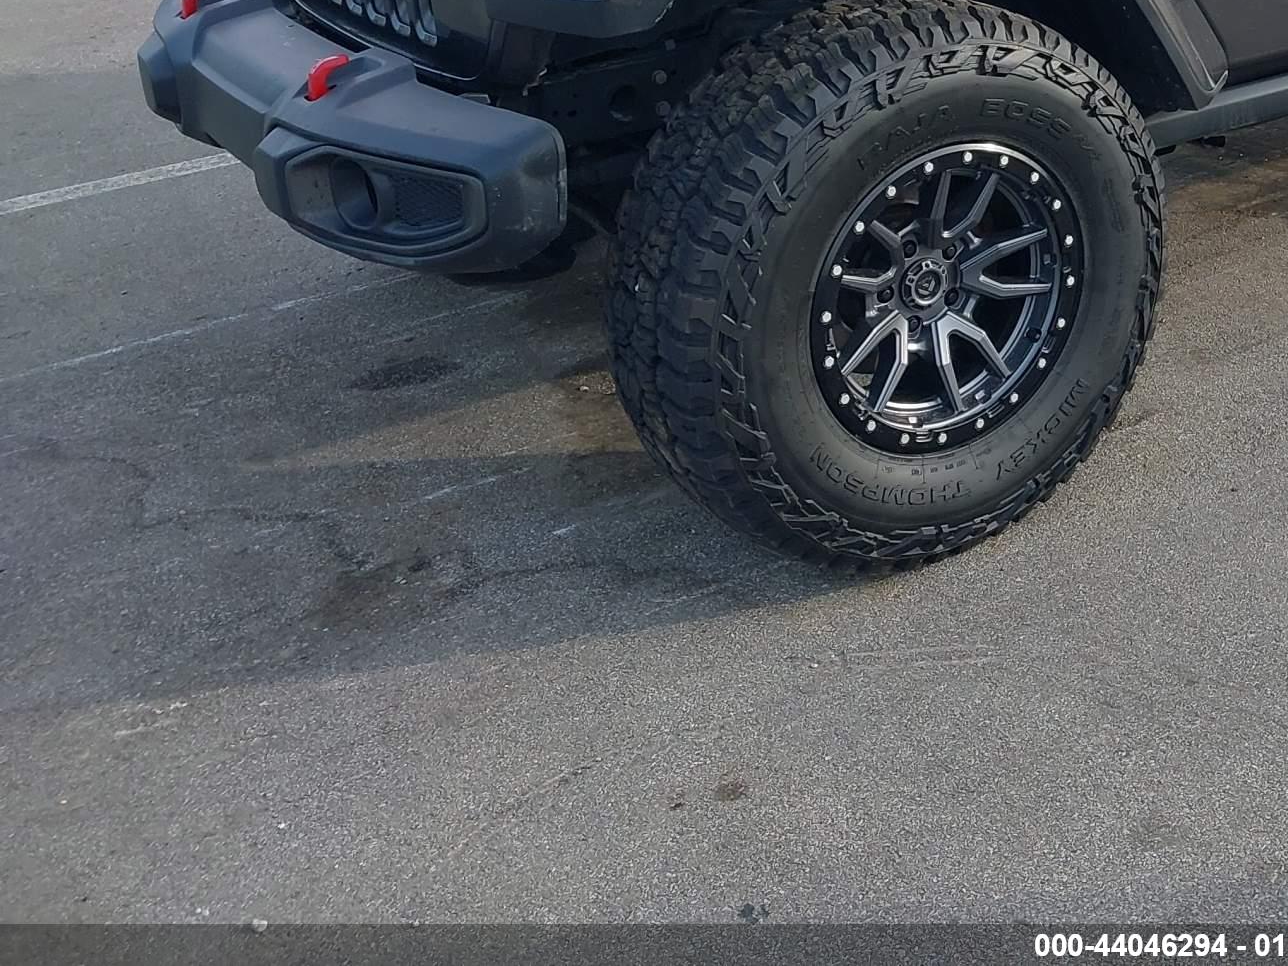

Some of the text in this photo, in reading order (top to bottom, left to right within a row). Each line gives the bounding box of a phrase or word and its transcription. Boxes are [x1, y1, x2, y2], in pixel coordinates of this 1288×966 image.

[978, 97, 1072, 135] BOSS
[798, 376, 1091, 507] MICKEY THOMPSON
